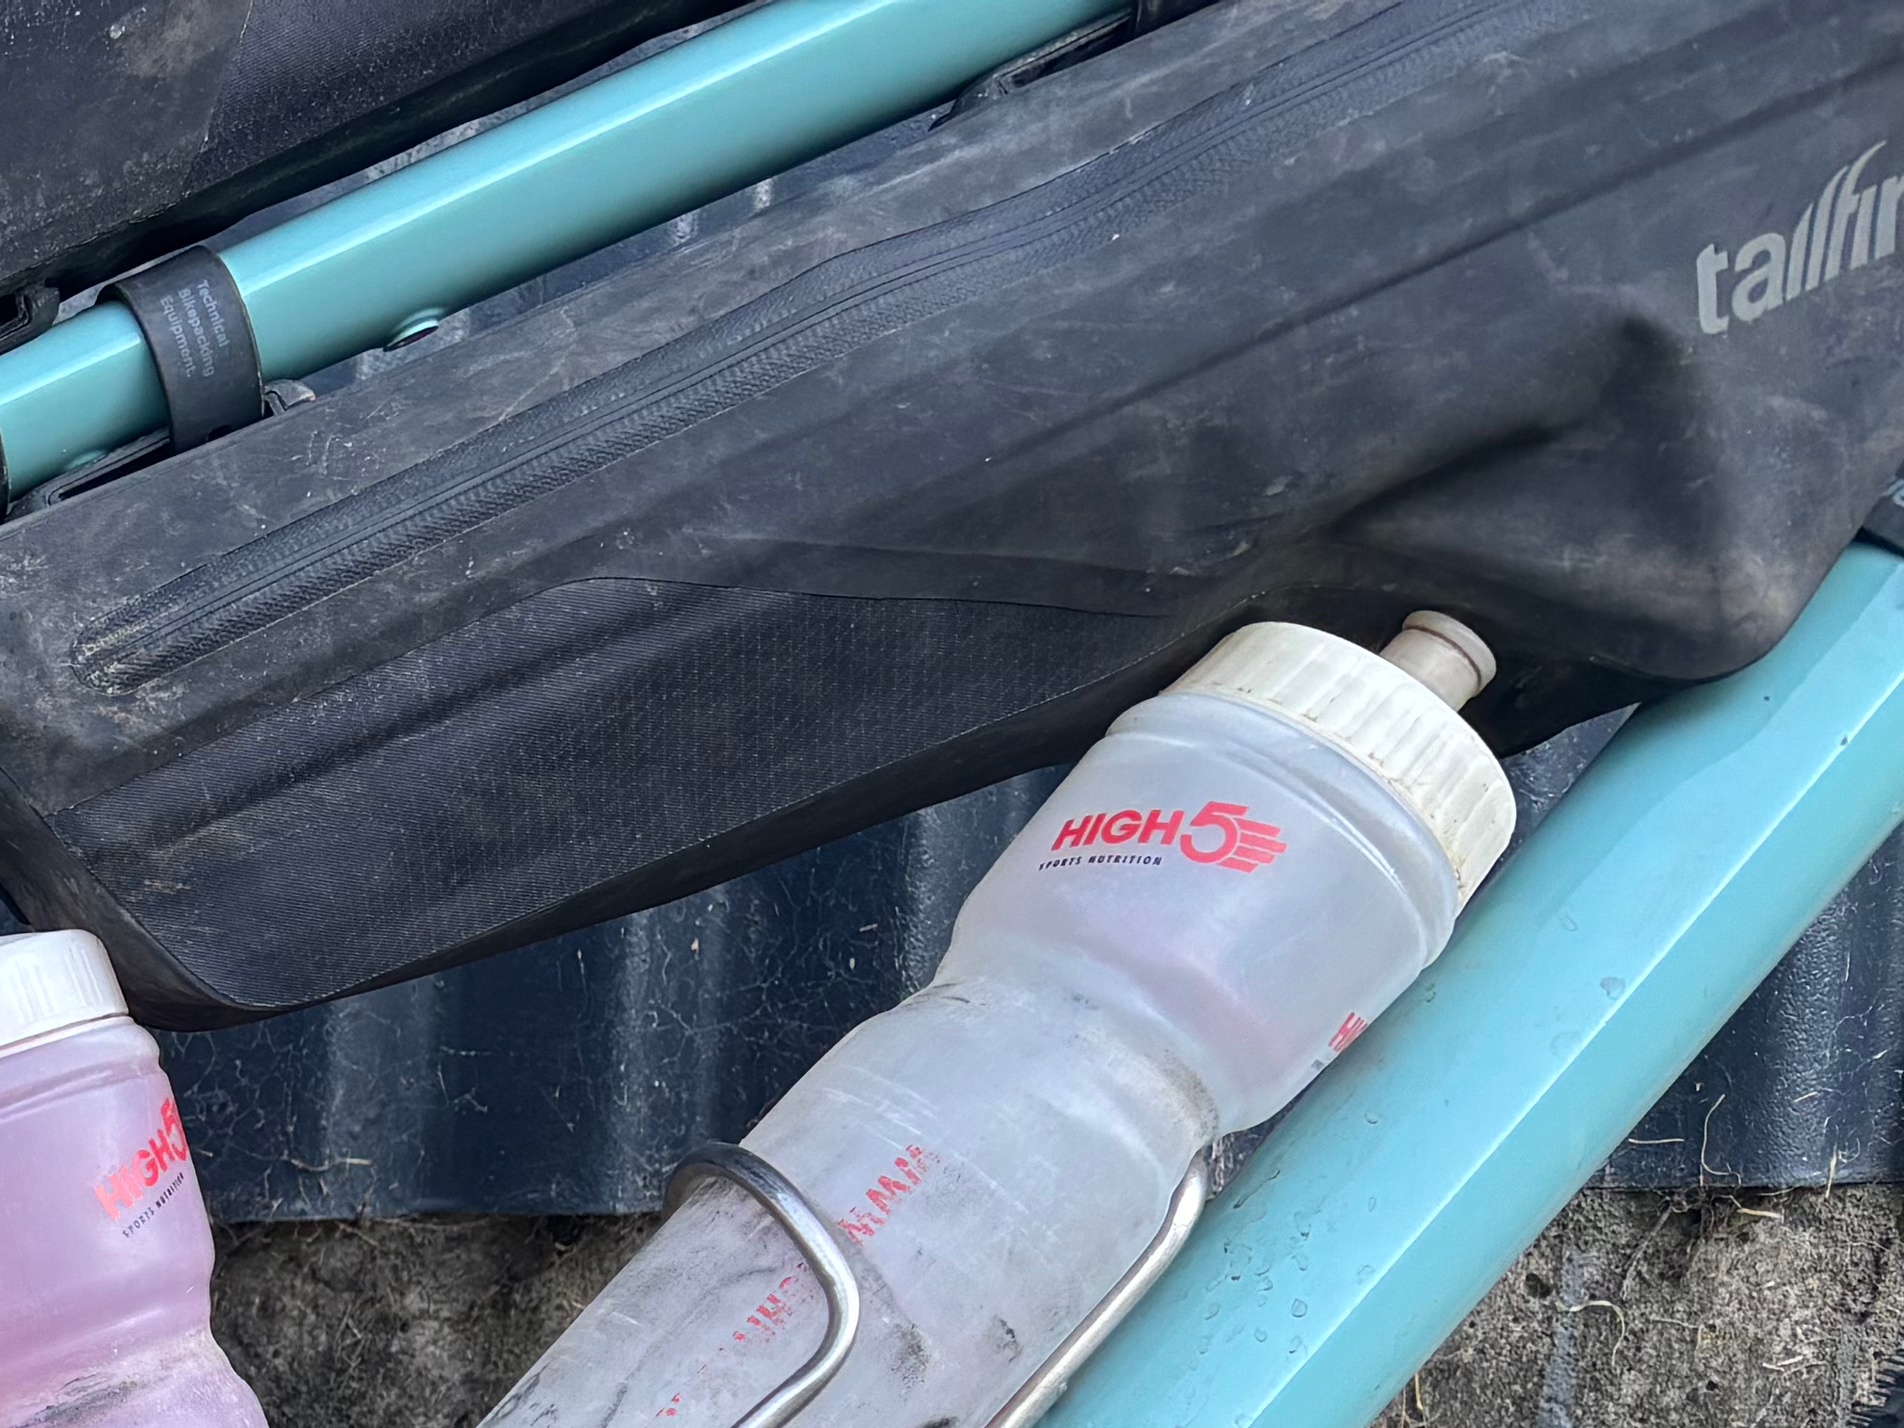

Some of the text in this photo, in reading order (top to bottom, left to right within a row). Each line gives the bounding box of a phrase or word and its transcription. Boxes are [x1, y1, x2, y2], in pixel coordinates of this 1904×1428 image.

[178, 287, 216, 377] Bikepacking
[196, 279, 230, 348] Technical
[1051, 800, 1262, 868] HIGH5
[1088, 854, 1163, 867] NUTRITION
